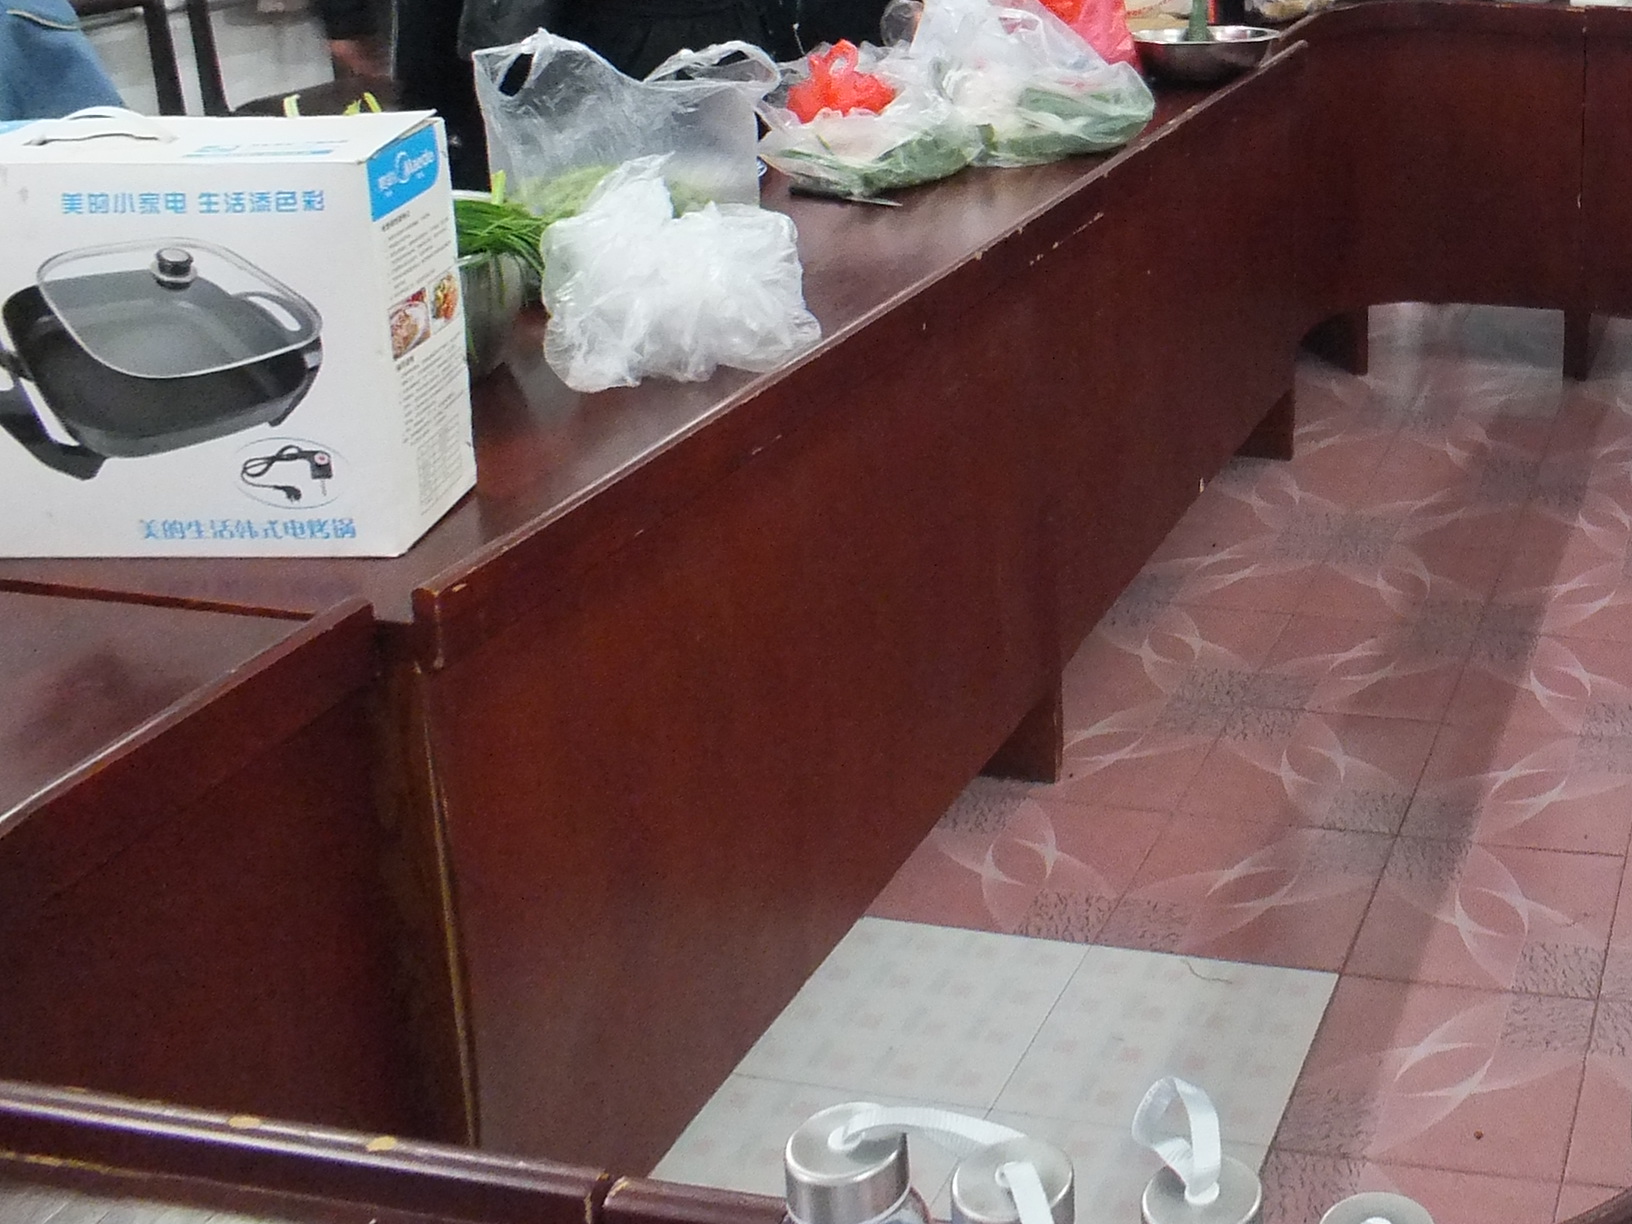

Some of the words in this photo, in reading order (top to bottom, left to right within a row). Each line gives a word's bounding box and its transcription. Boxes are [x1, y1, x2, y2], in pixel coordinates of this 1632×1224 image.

[61, 191, 187, 215] 美的小家电
[198, 189, 325, 214] 生活添色彩
[140, 517, 358, 540] 美的生活韩式电烤锅
